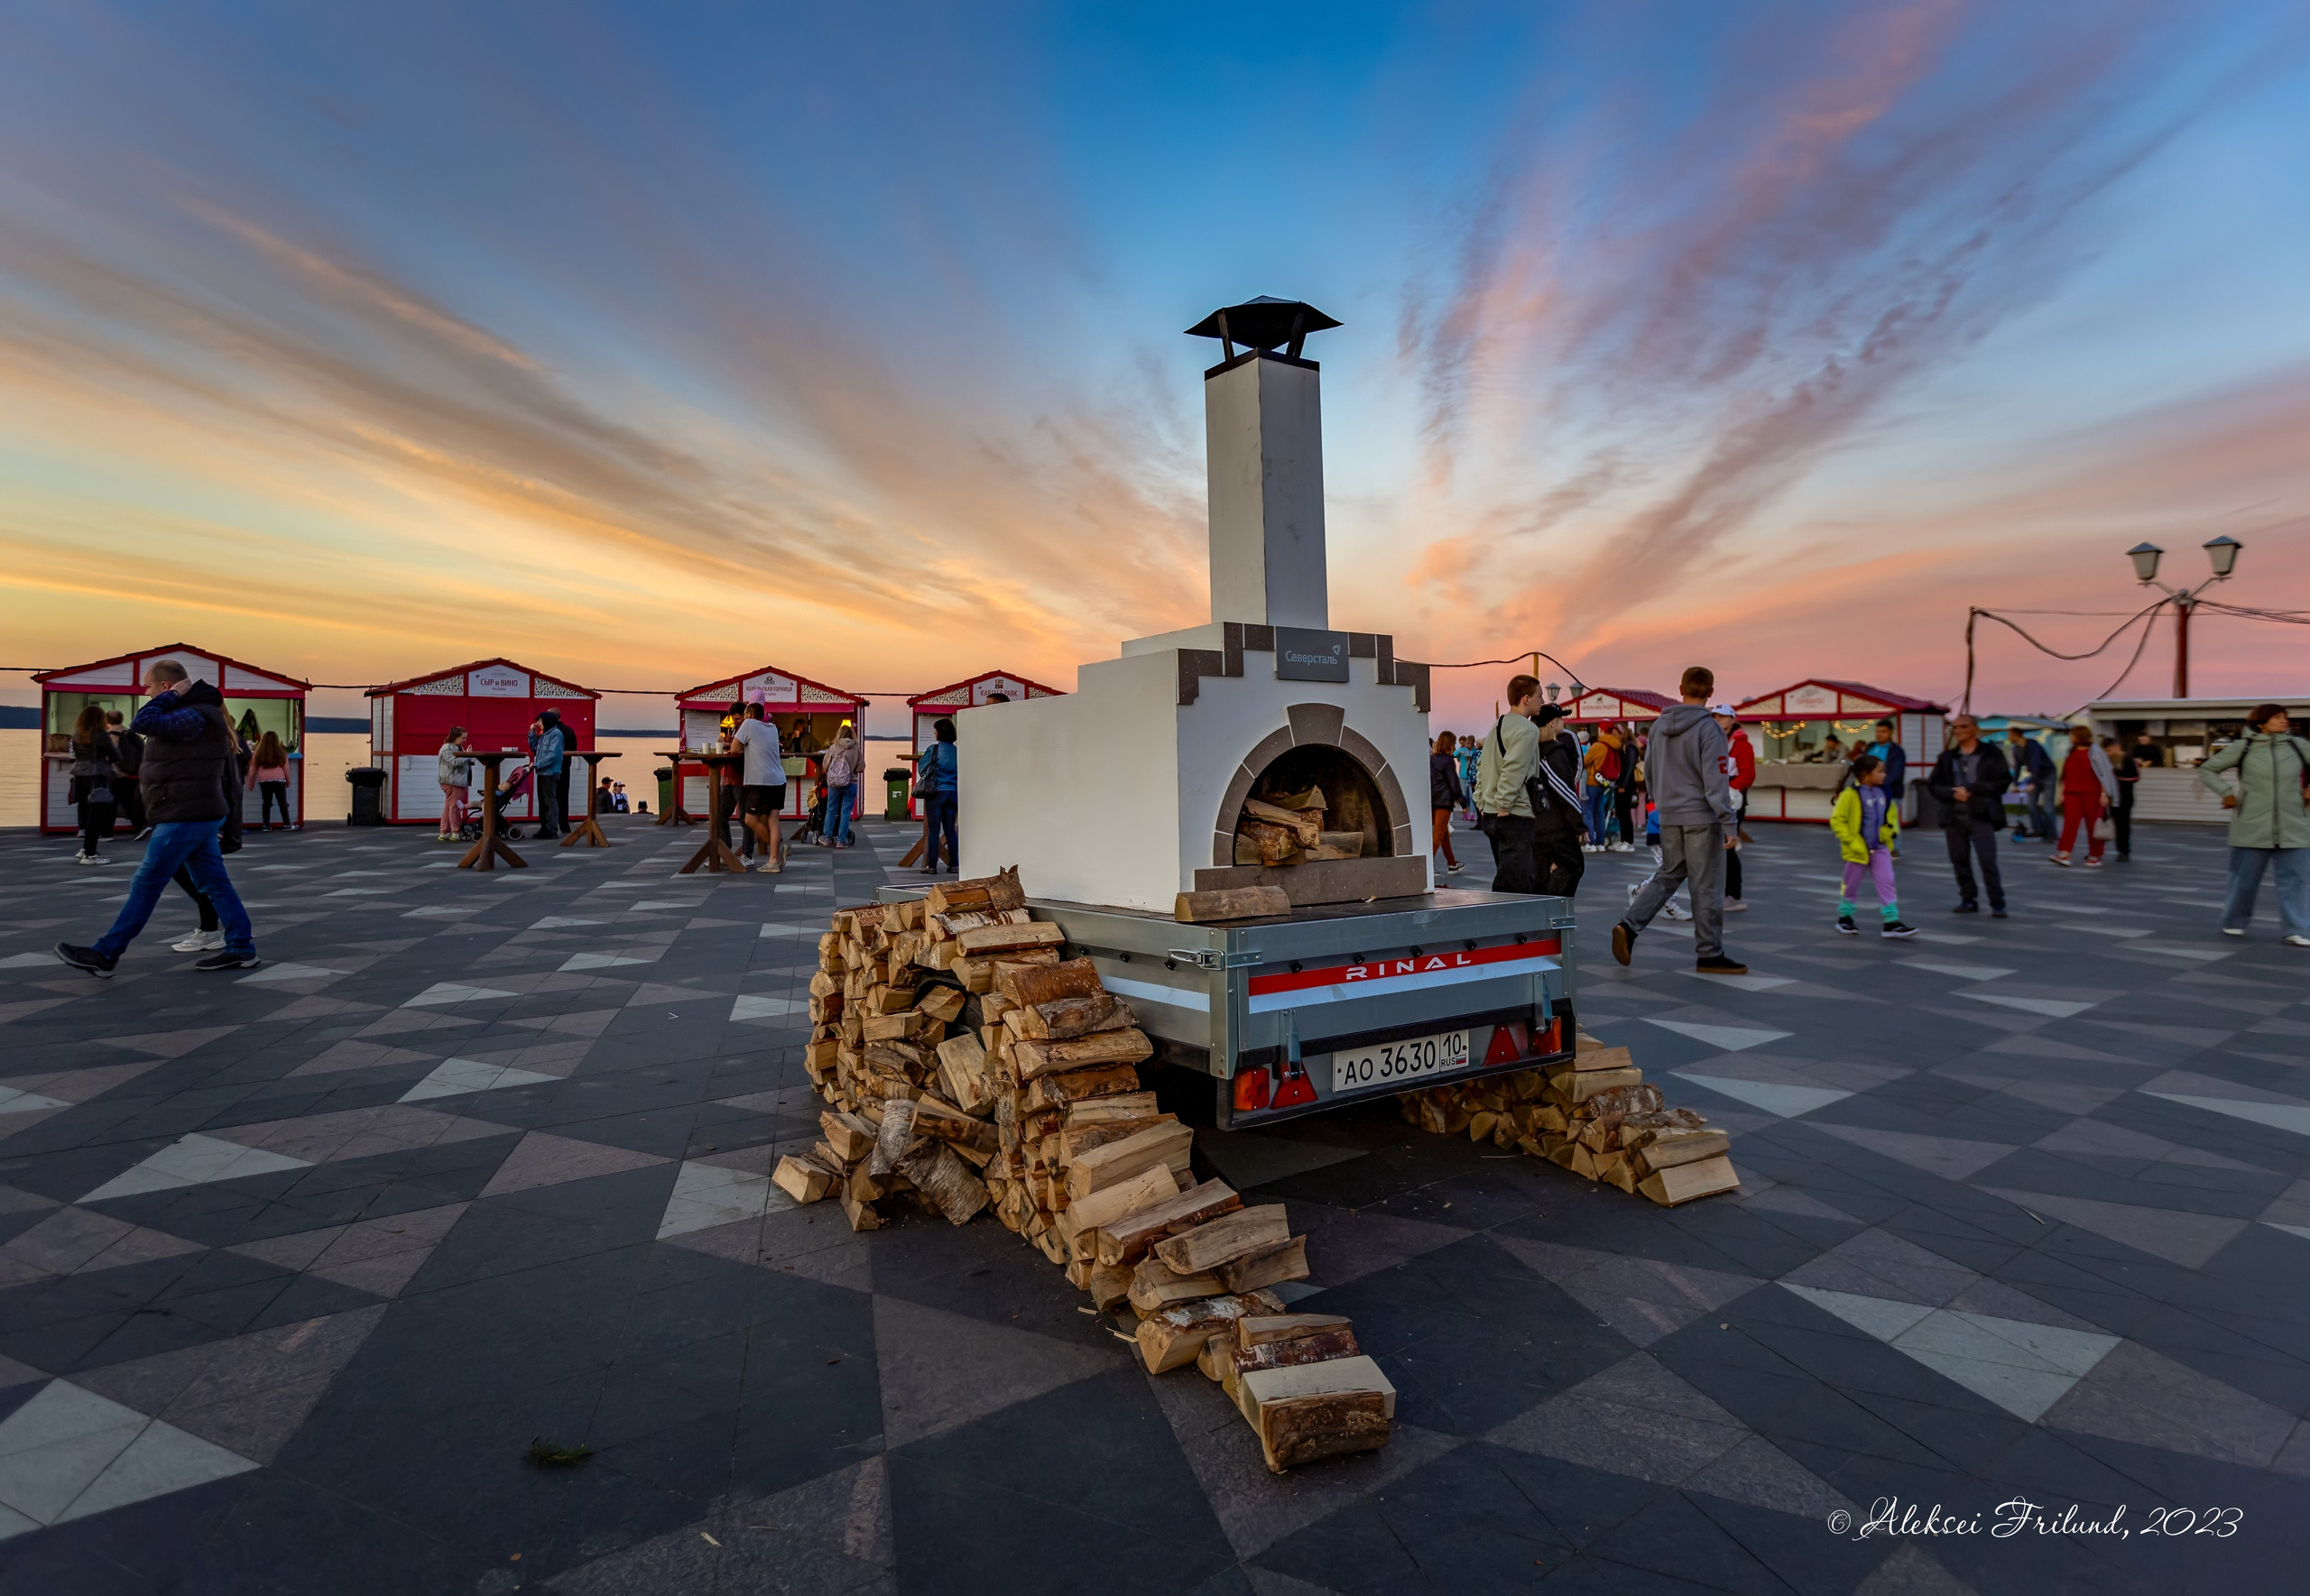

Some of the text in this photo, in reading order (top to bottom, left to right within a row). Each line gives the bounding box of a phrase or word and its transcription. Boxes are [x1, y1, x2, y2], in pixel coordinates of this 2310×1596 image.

[1285, 650, 1338, 666] Северсталь
[480, 678, 494, 687] СЫР
[500, 678, 518, 687] ВИНО
[1345, 953, 1472, 981] RINAL
[1443, 1033, 1462, 1057] 10
[1380, 1040, 1437, 1078] 3630
[1440, 1056, 1456, 1068] RUS
